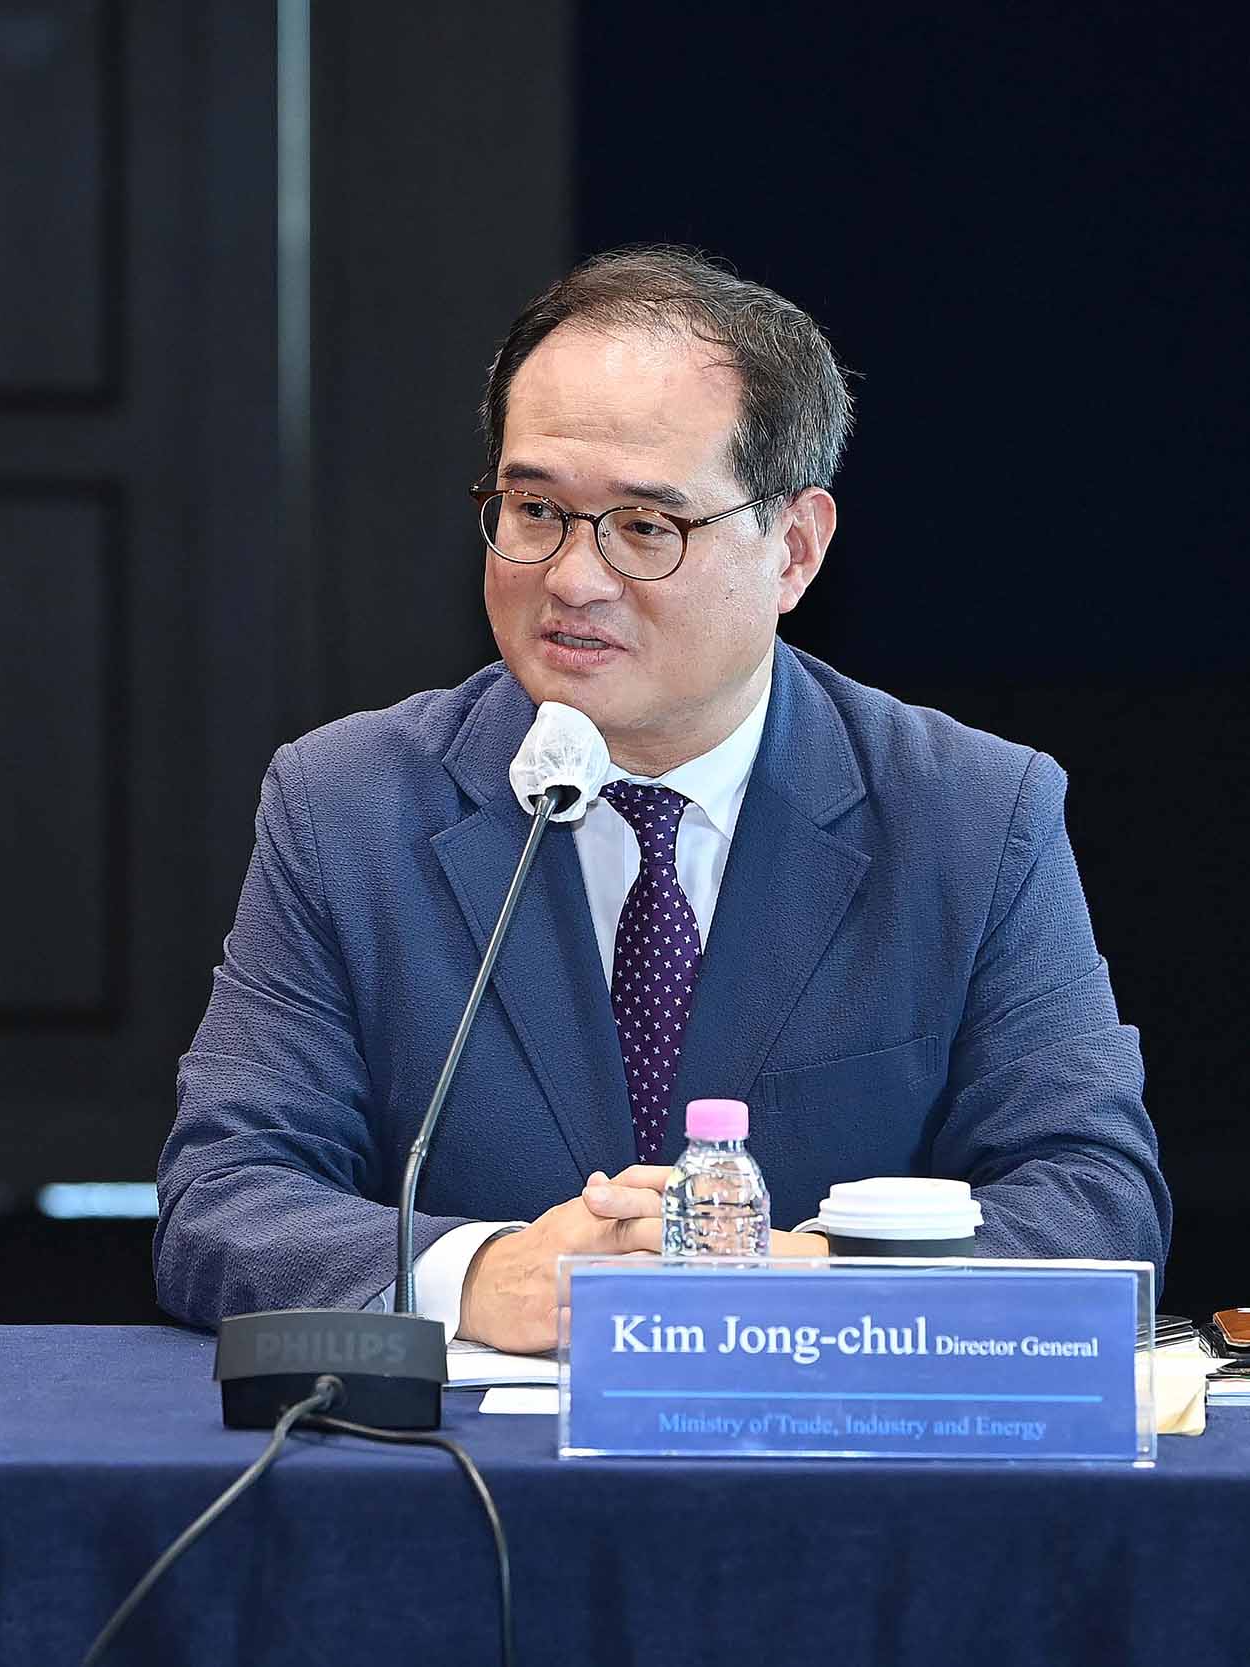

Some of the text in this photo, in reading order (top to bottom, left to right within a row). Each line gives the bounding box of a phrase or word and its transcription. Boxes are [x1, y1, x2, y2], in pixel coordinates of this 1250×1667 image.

[256, 1331, 407, 1363] PHILIPS
[611, 1314, 1099, 1365] Kim Jong-chul Director General
[658, 1412, 1047, 1441] Ministry of Trade, Industry and Energy
